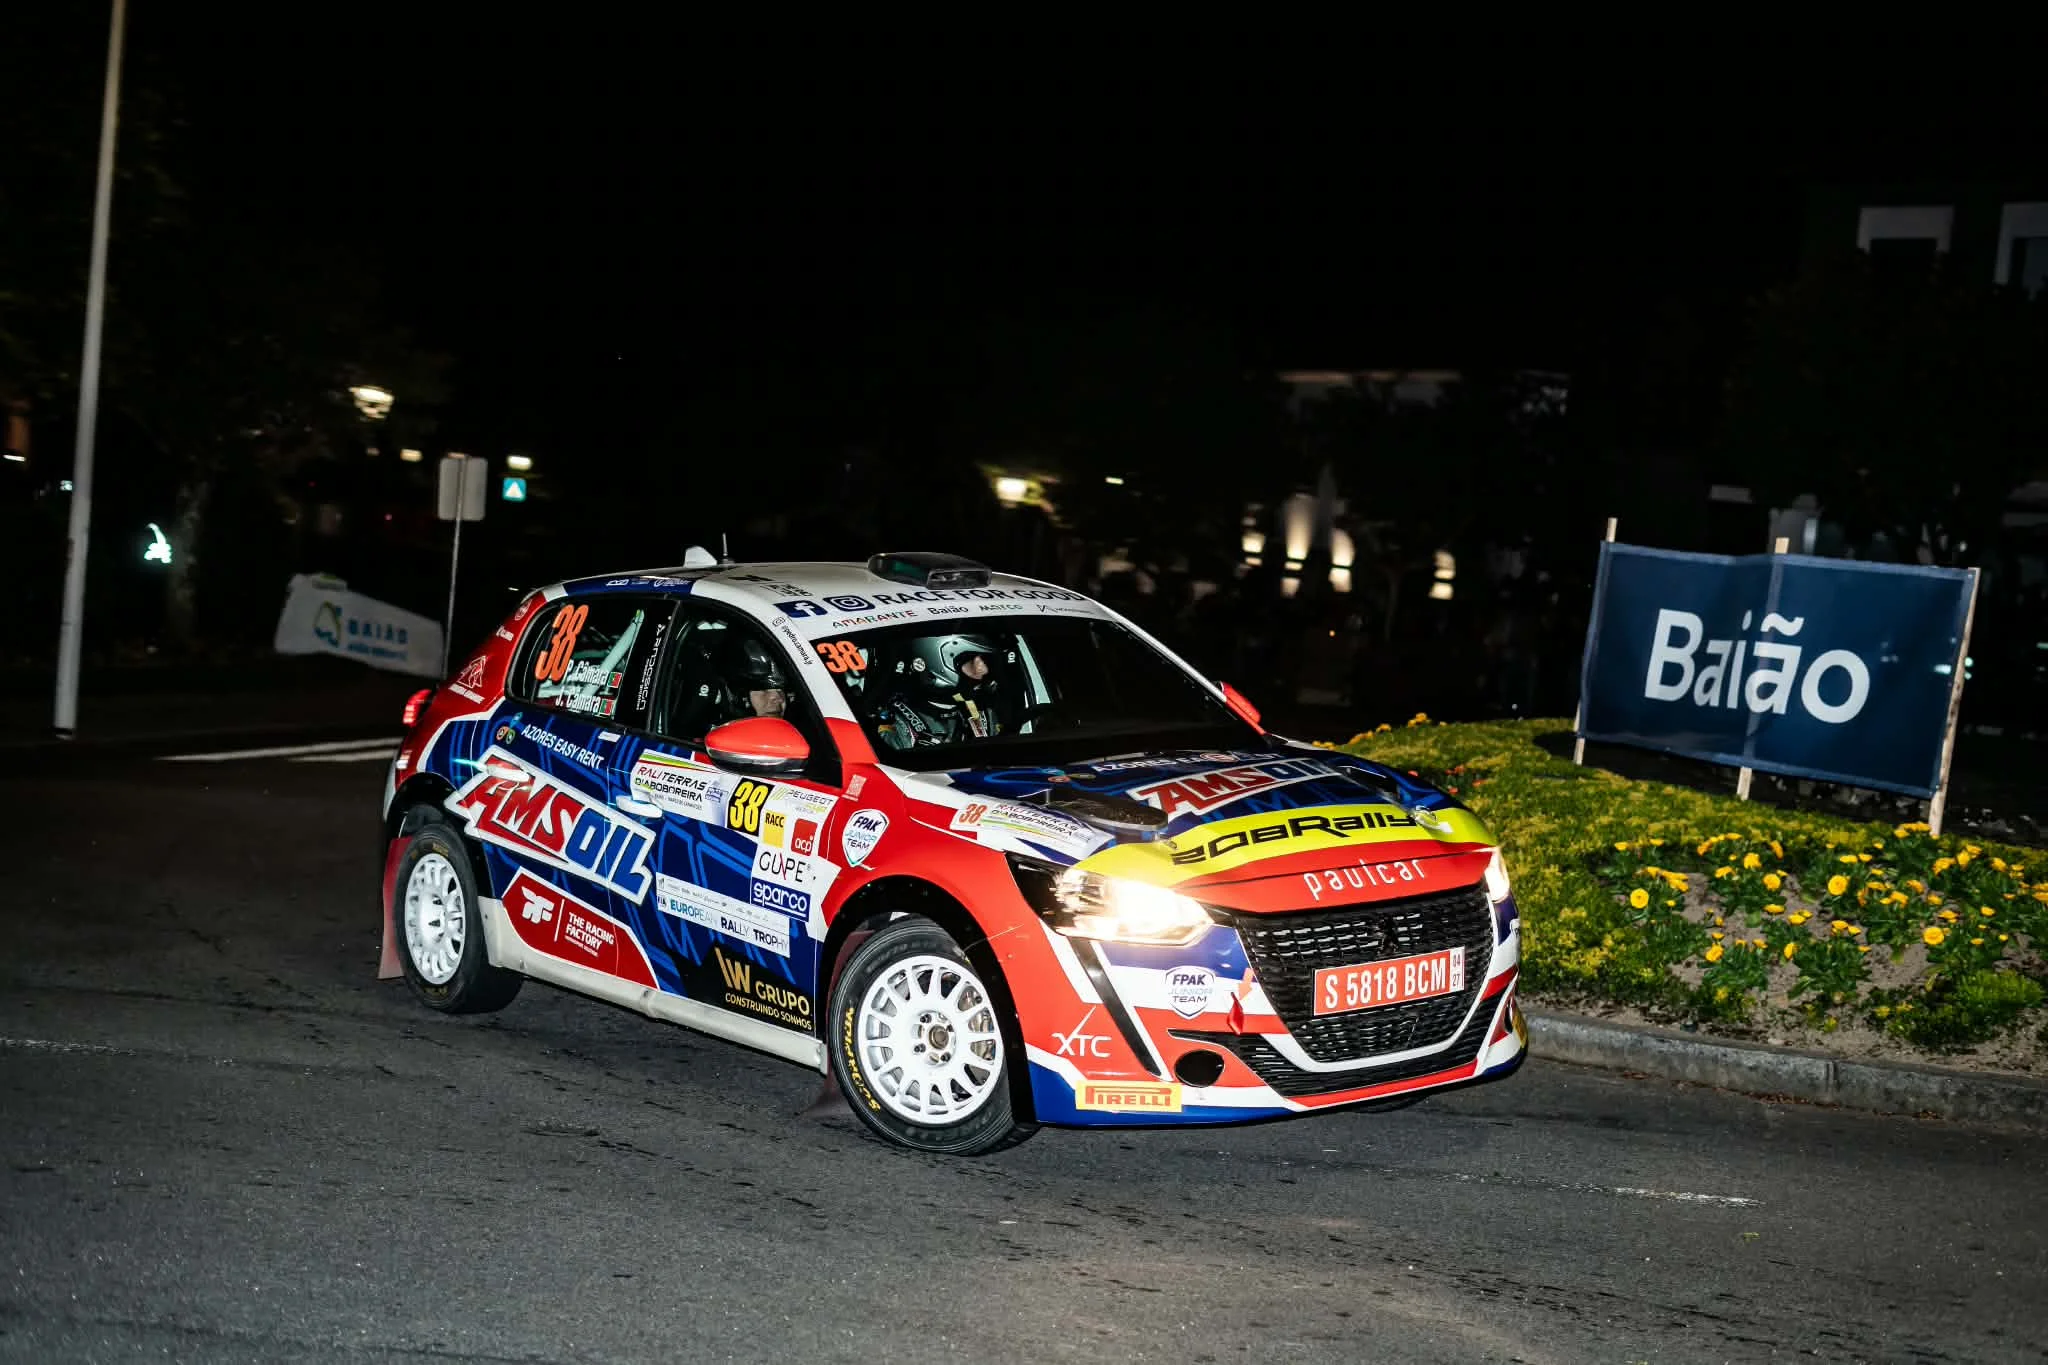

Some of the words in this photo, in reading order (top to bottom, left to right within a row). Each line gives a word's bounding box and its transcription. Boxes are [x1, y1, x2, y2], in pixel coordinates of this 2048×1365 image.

[872, 589, 955, 605] RACE
[956, 589, 1016, 600] FOR
[1014, 589, 1087, 601] GOOD
[832, 610, 918, 629] AMARANTE
[928, 604, 969, 616] Baião
[535, 603, 590, 681] 38
[816, 640, 868, 675] 38
[1644, 608, 1870, 724] Baião
[555, 686, 564, 706] J.
[521, 723, 557, 749] AZORES
[553, 738, 581, 759] EASY
[576, 748, 605, 770] RENT
[730, 781, 769, 832] 38
[765, 812, 785, 828] RACC
[959, 803, 988, 825] 38
[456, 753, 648, 896] AMSOIL
[853, 816, 883, 832] FPAK
[847, 838, 870, 850] TEAM
[753, 881, 808, 912] sparco
[565, 923, 602, 951] FACTORY
[568, 911, 586, 929] THE
[585, 920, 615, 945] RACING
[720, 916, 749, 937] RALLY
[753, 928, 789, 952] TROPHY
[1172, 973, 1207, 986] FPAK
[1325, 974, 1338, 1009] S
[1346, 966, 1397, 1007] 5818
[1404, 957, 1447, 997] BCM
[725, 992, 780, 1018] CONSTRUINDO
[780, 1011, 812, 1031] SONHOS
[755, 981, 810, 1017] GRUPO
[1172, 995, 1208, 1003] TEAM
[1051, 1004, 1113, 1058] XTC
[1085, 1085, 1173, 1107] PIRELLI
